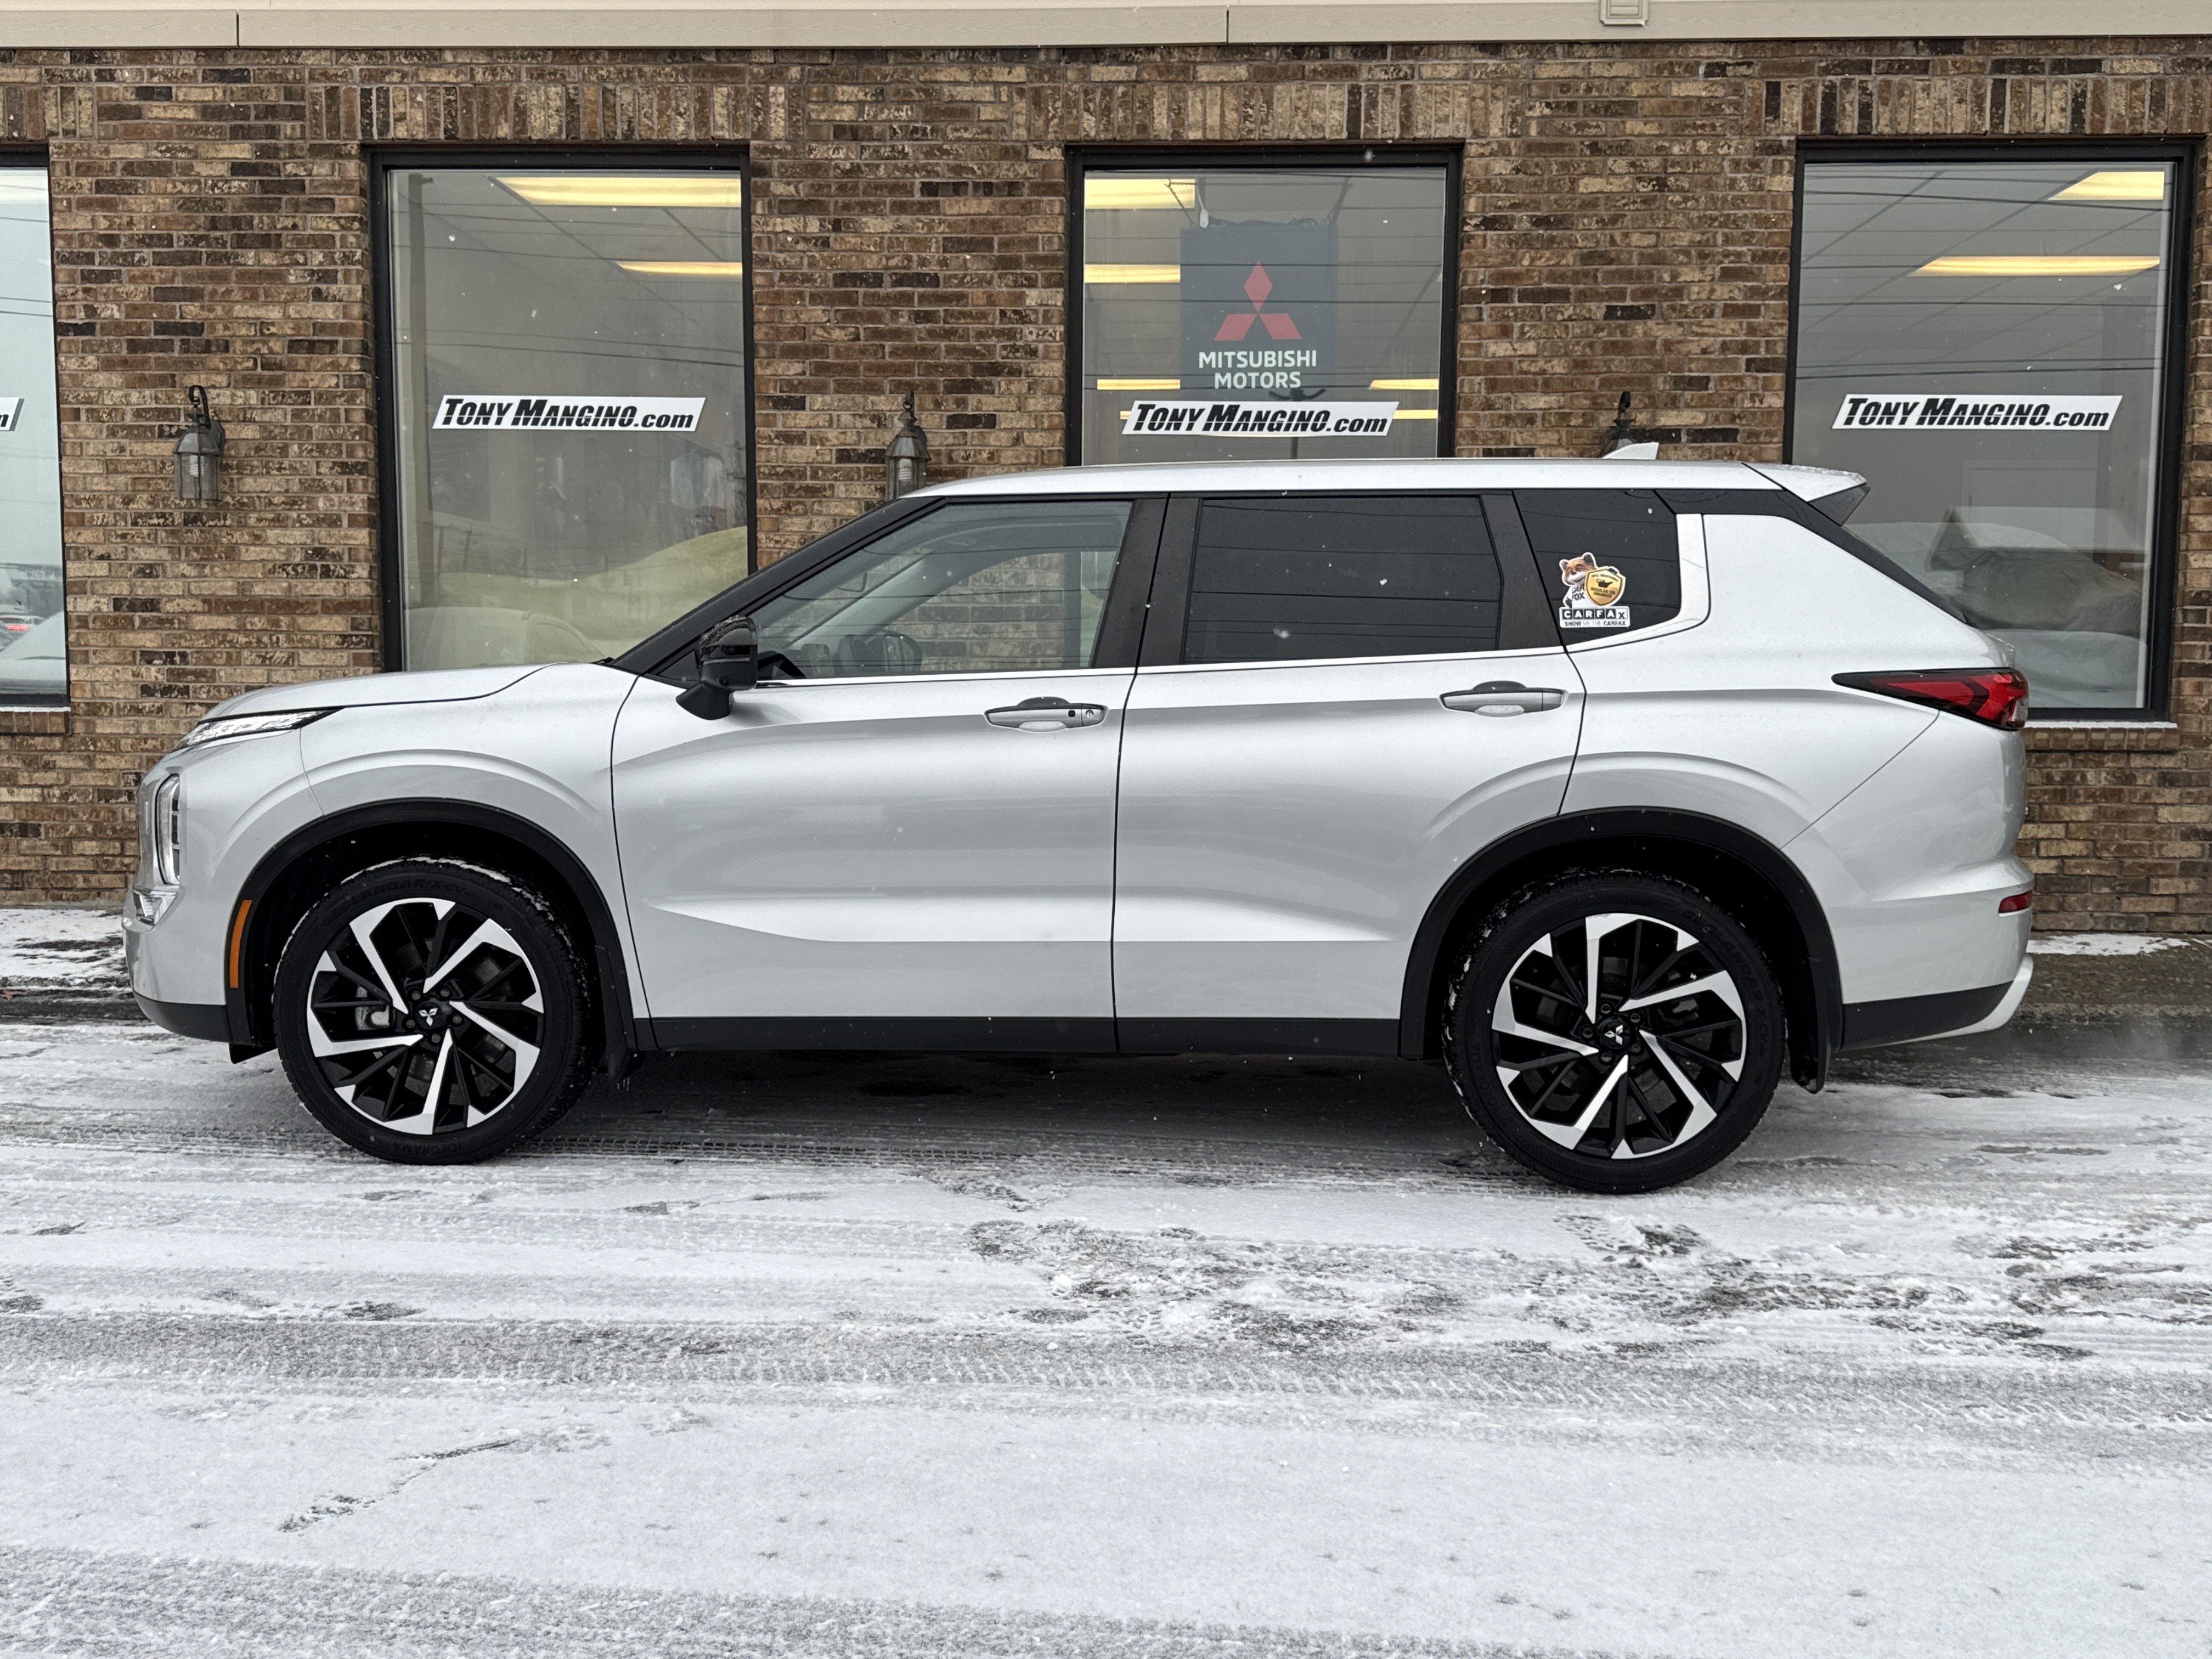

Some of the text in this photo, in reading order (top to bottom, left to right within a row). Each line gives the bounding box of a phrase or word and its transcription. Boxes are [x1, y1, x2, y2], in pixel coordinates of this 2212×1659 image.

[1199, 351, 1317, 369] MITSUBISHI
[1215, 371, 1301, 388] MOTORS
[1572, 592, 1585, 601] FOX
[1564, 610, 1625, 619] CARFAX
